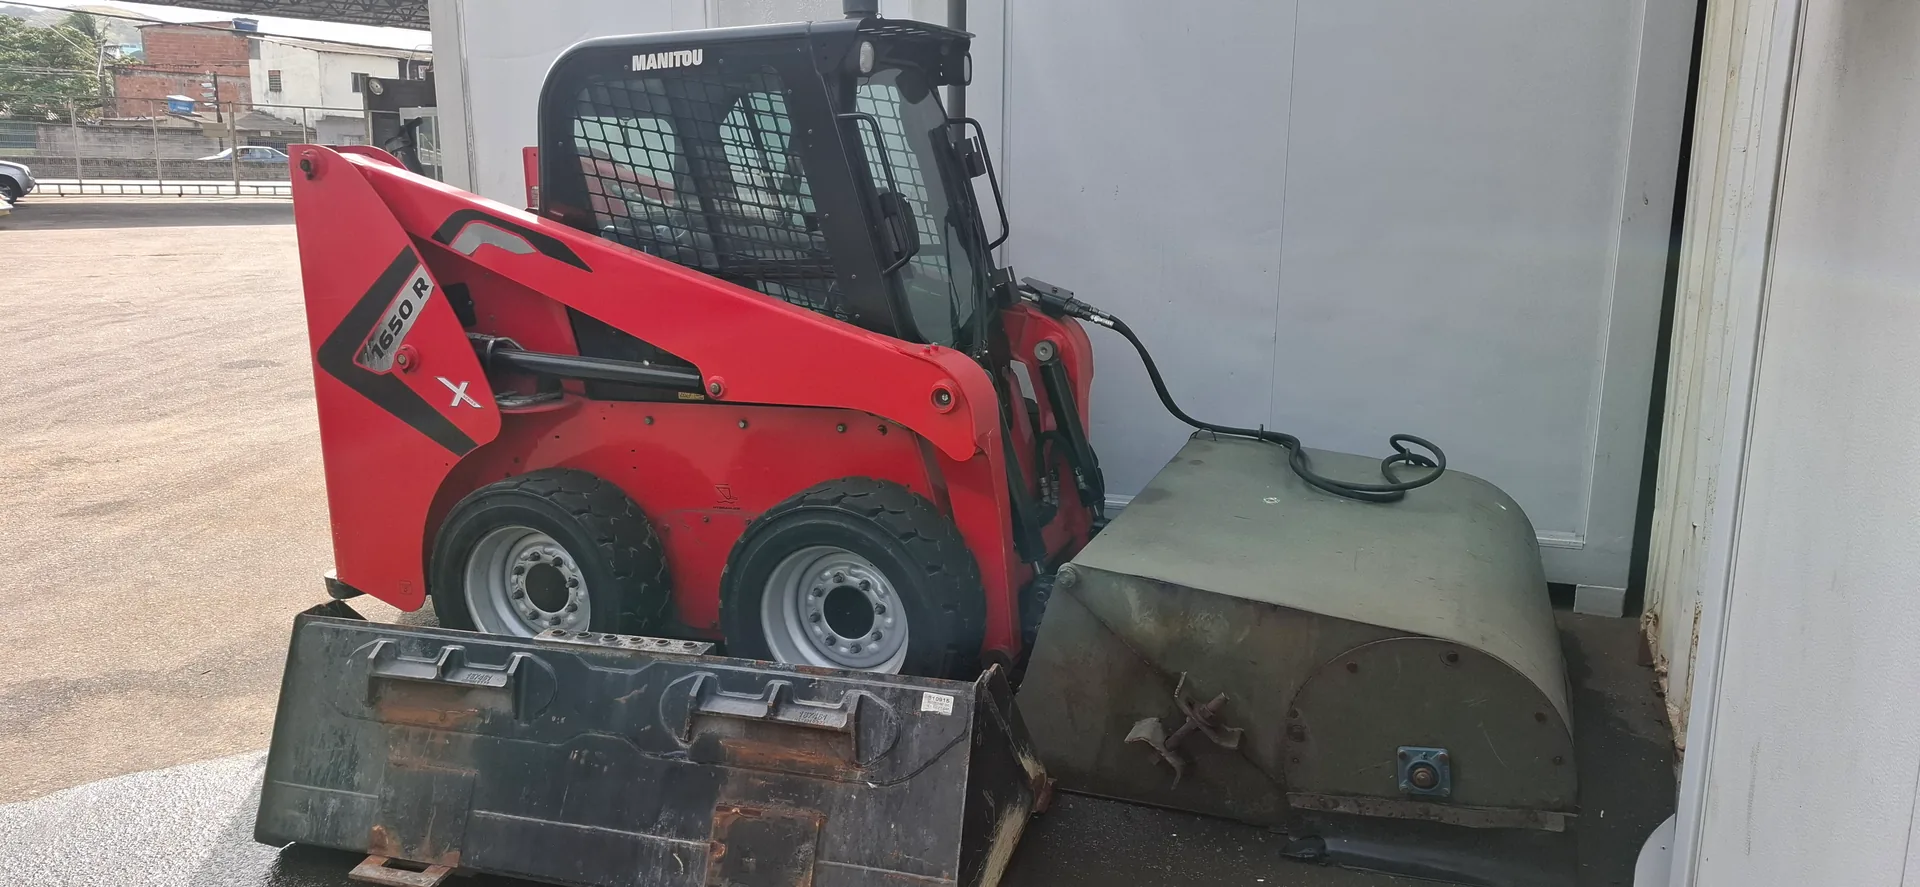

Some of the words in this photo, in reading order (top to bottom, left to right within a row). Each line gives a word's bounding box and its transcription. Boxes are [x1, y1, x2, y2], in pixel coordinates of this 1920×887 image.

[632, 49, 703, 71] MANITOU
[371, 299, 413, 360] 1650
[412, 277, 430, 299] R
[434, 376, 483, 408] X
